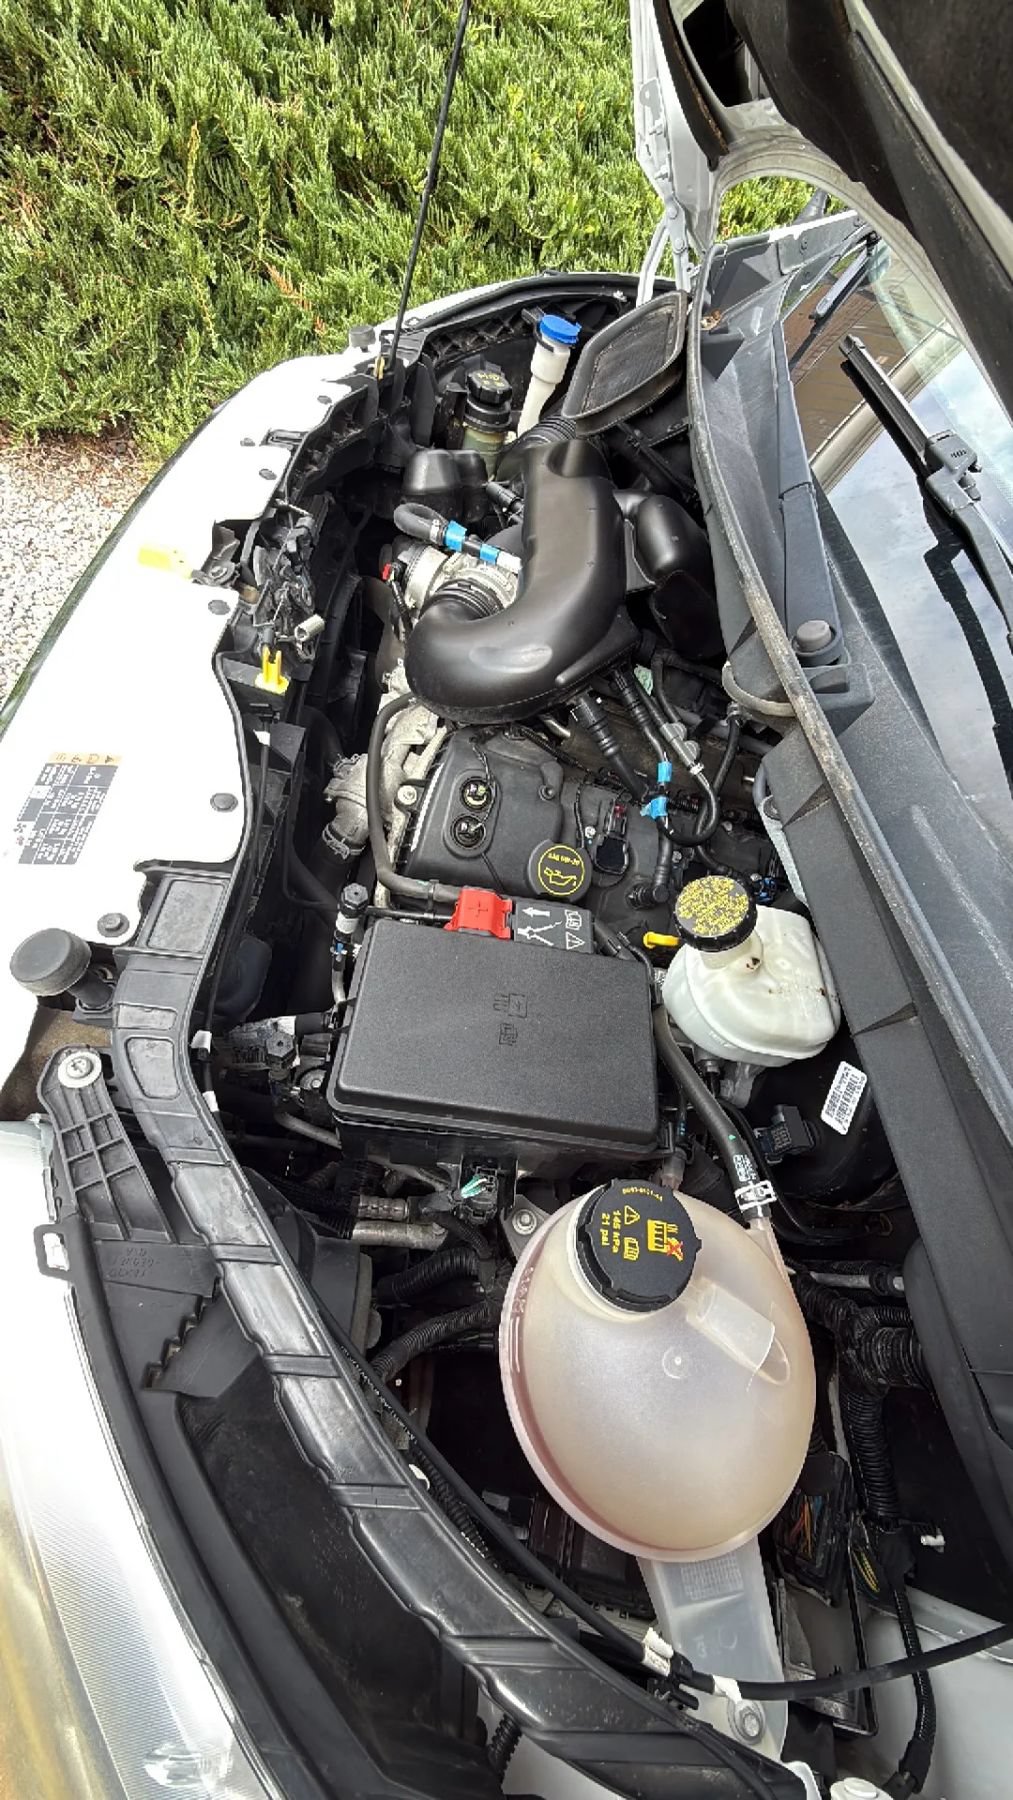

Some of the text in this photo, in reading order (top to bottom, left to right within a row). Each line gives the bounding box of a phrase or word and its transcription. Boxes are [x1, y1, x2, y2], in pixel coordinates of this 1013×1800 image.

[600, 1213, 611, 1246] 21 psi
[612, 1210, 622, 1253] 145 kPa
